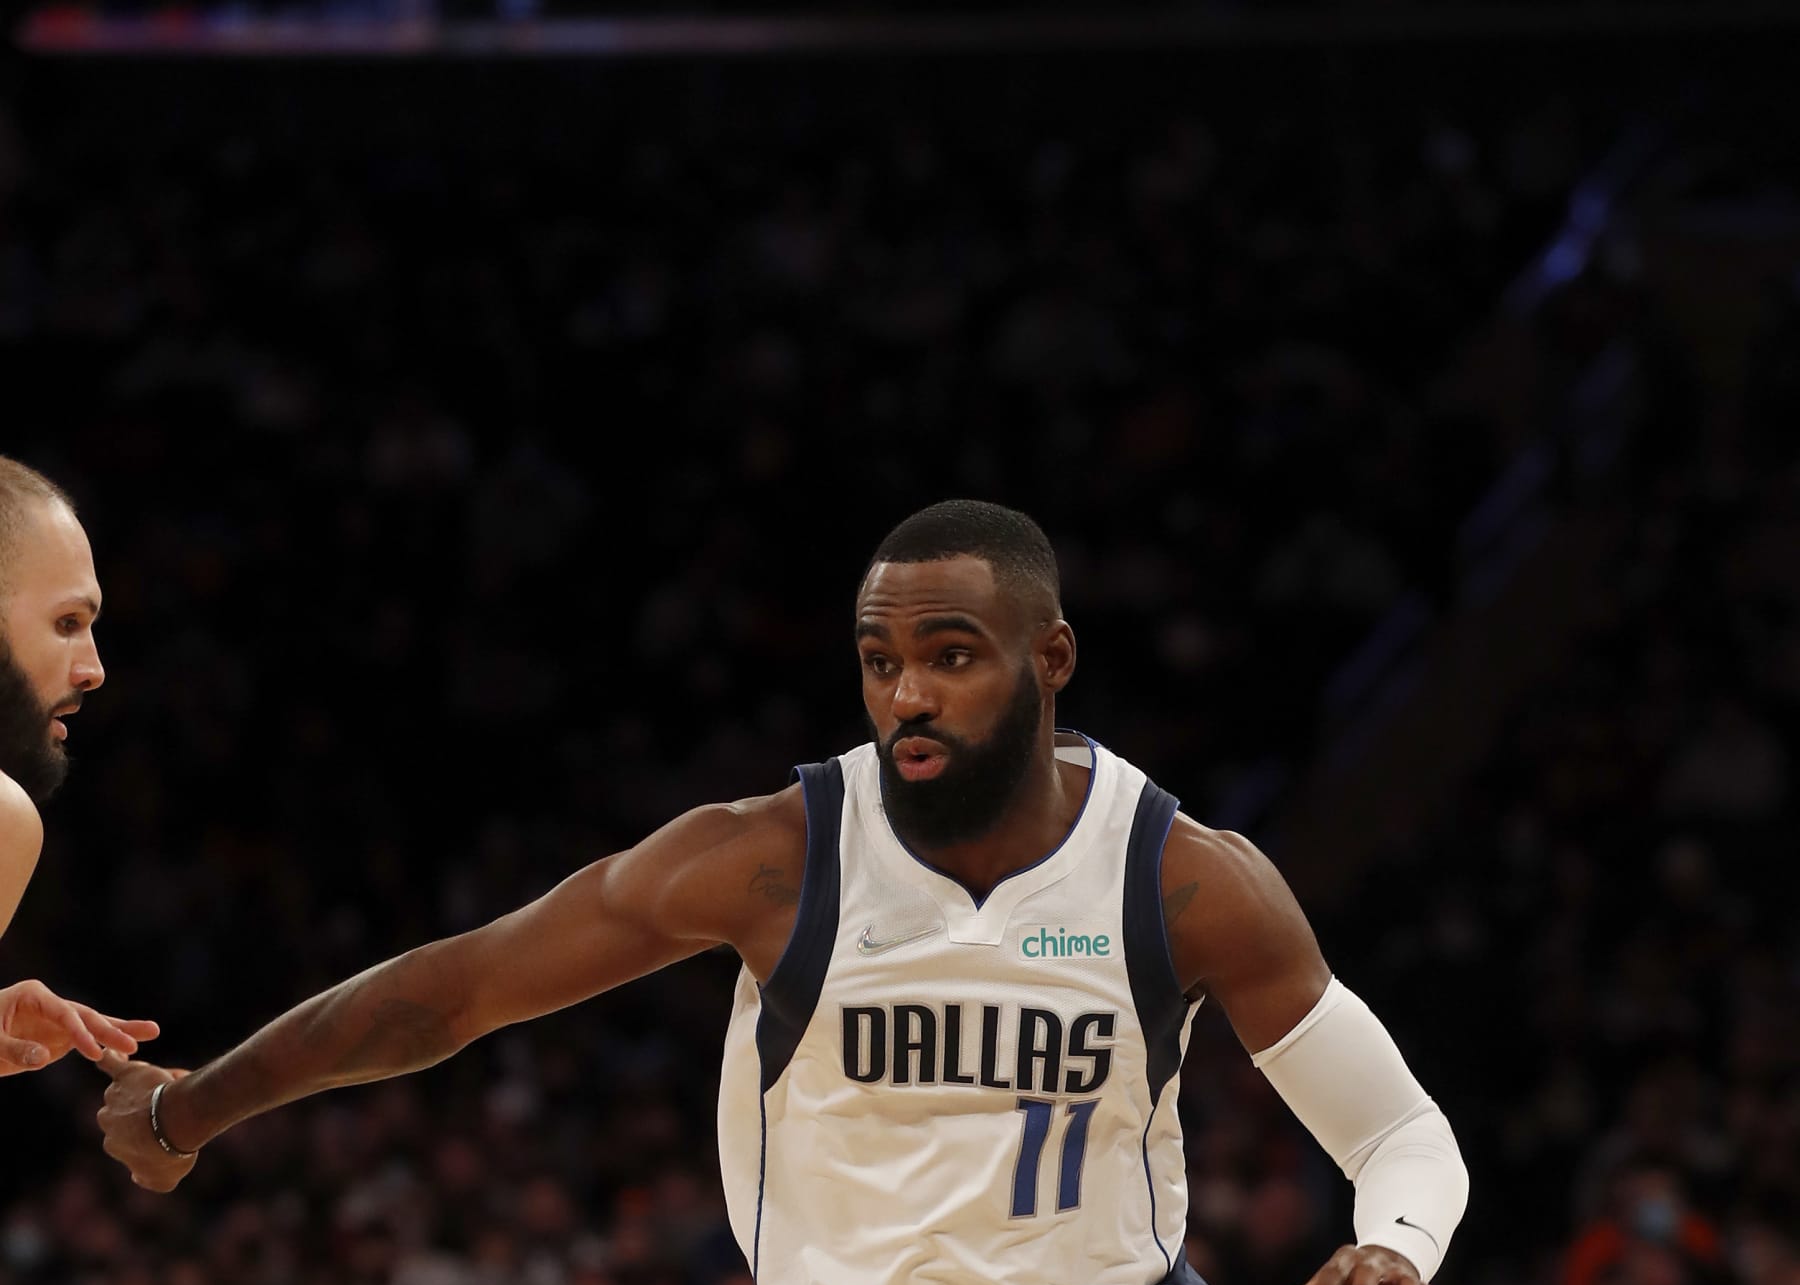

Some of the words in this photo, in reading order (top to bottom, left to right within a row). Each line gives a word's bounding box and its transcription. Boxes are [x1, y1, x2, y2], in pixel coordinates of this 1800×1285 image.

[1022, 927, 1110, 958] chime
[839, 1001, 1119, 1095] DALLAS
[1008, 1096, 1102, 1219] 11
